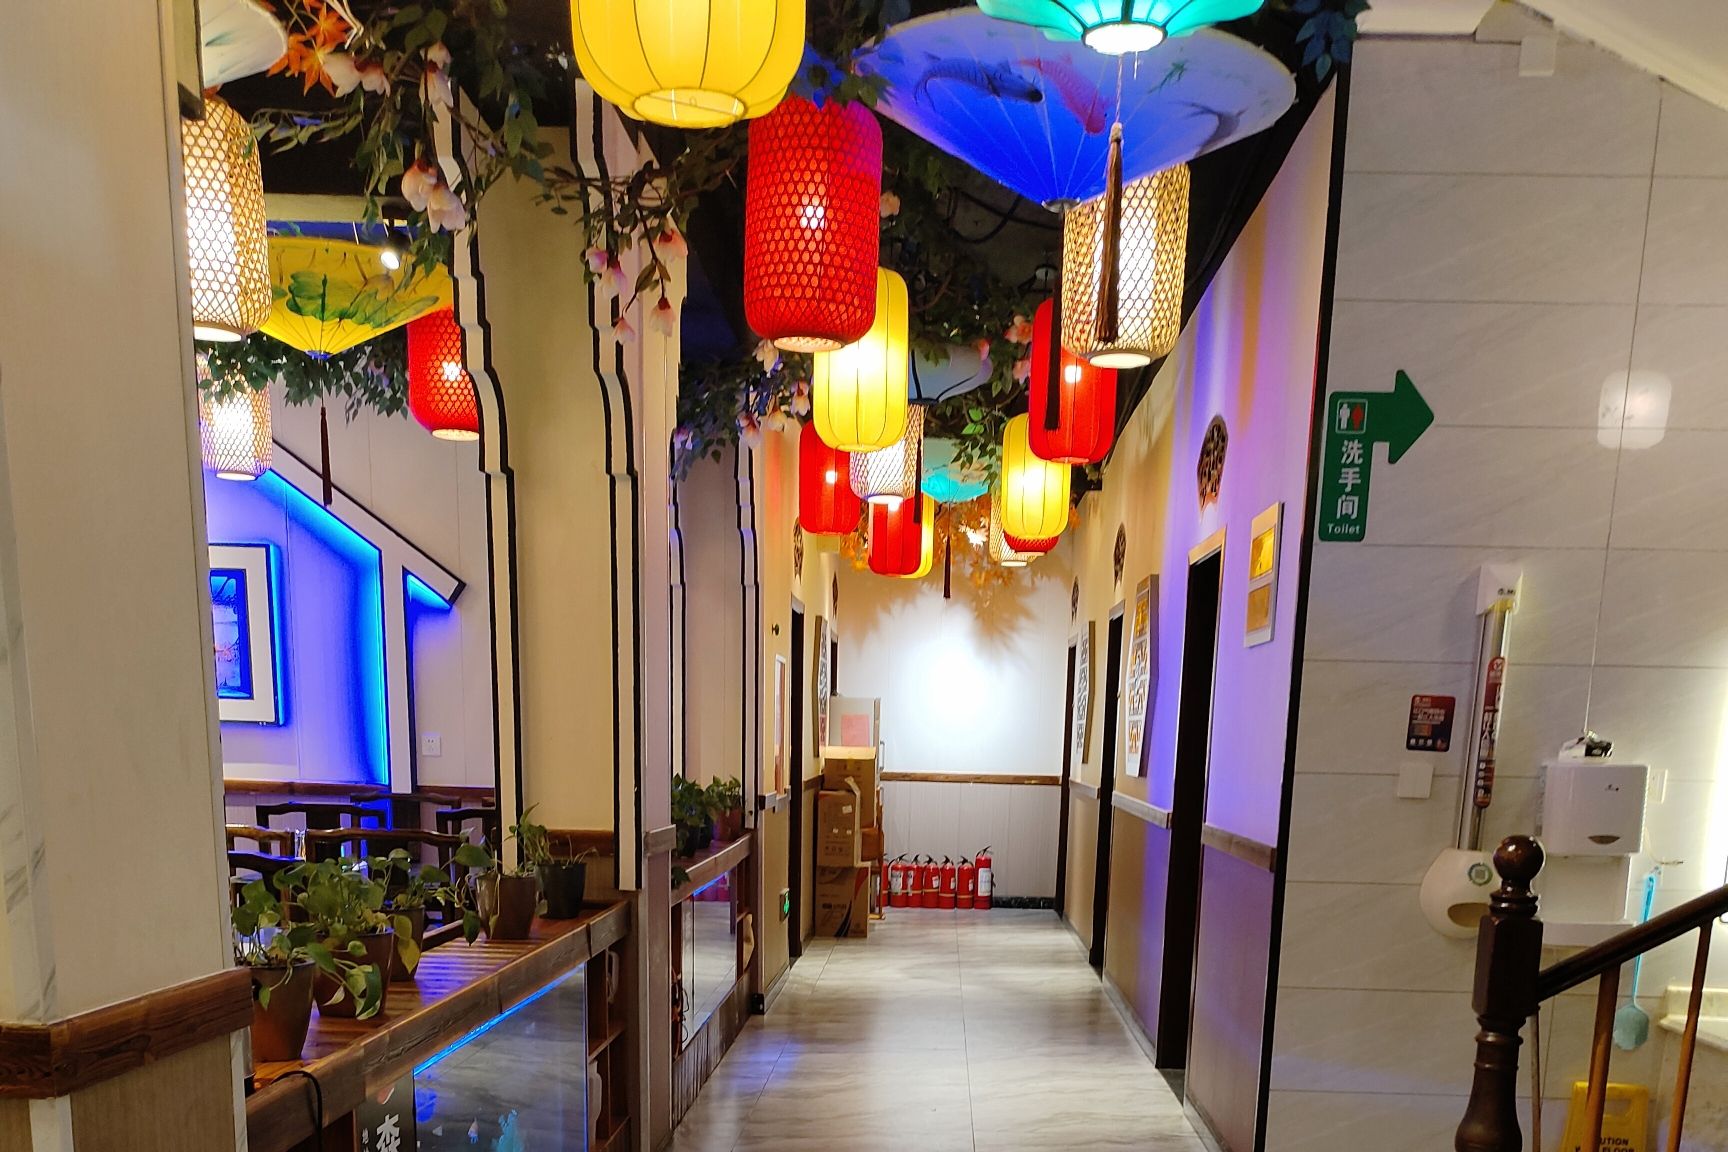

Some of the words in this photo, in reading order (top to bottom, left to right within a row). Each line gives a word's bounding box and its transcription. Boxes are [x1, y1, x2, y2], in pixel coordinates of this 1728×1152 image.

[1336, 440, 1363, 519] 洗手间
[1328, 524, 1360, 534] Toilet
